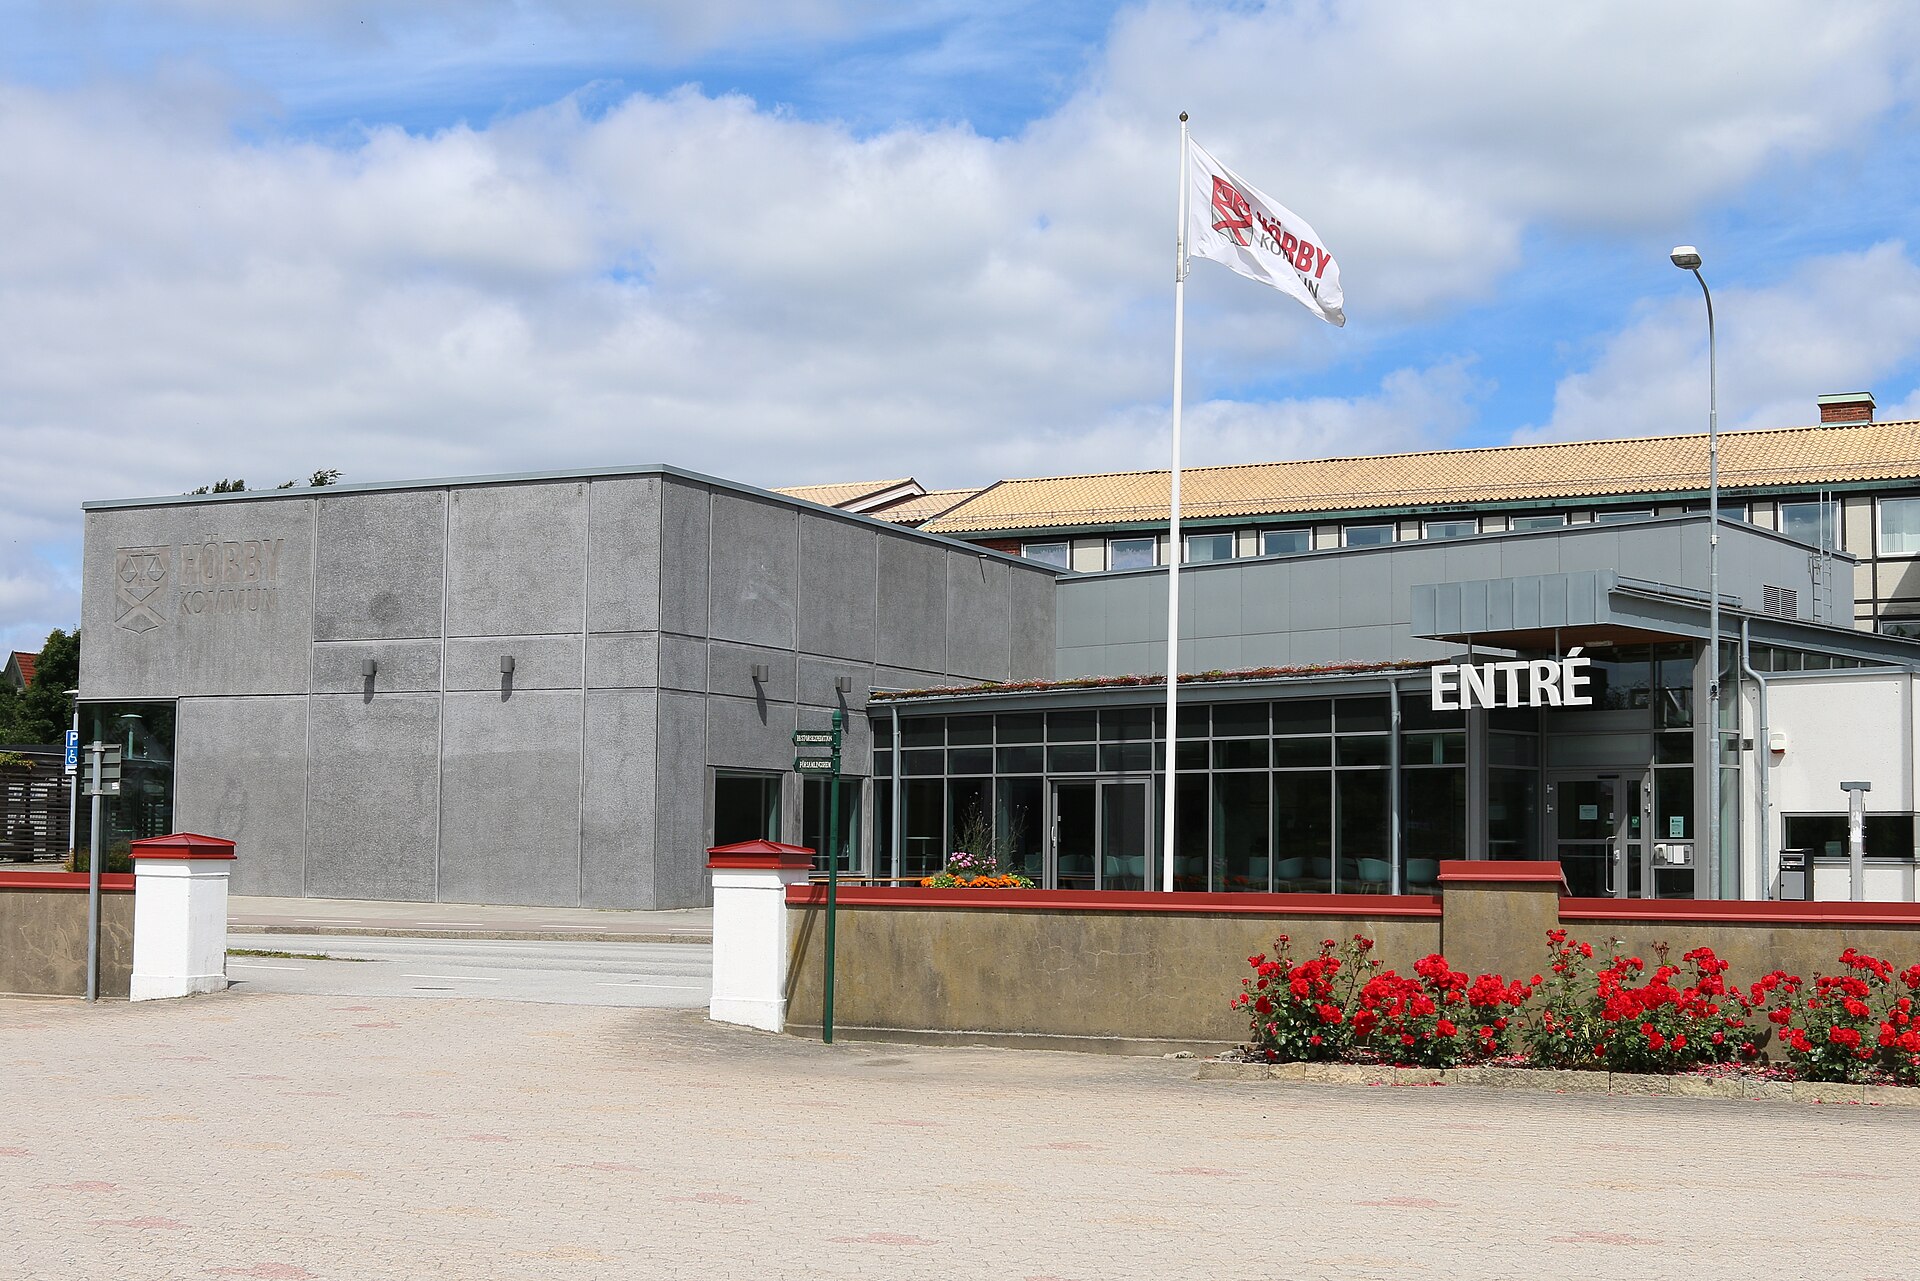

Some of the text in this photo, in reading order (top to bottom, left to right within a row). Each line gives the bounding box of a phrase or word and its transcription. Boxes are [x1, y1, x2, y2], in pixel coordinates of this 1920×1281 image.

[180, 533, 285, 587] HÖRBY
[179, 587, 279, 615] KOMMUN
[1431, 646, 1593, 711] ENTRÉ
[70, 731, 79, 746] P
